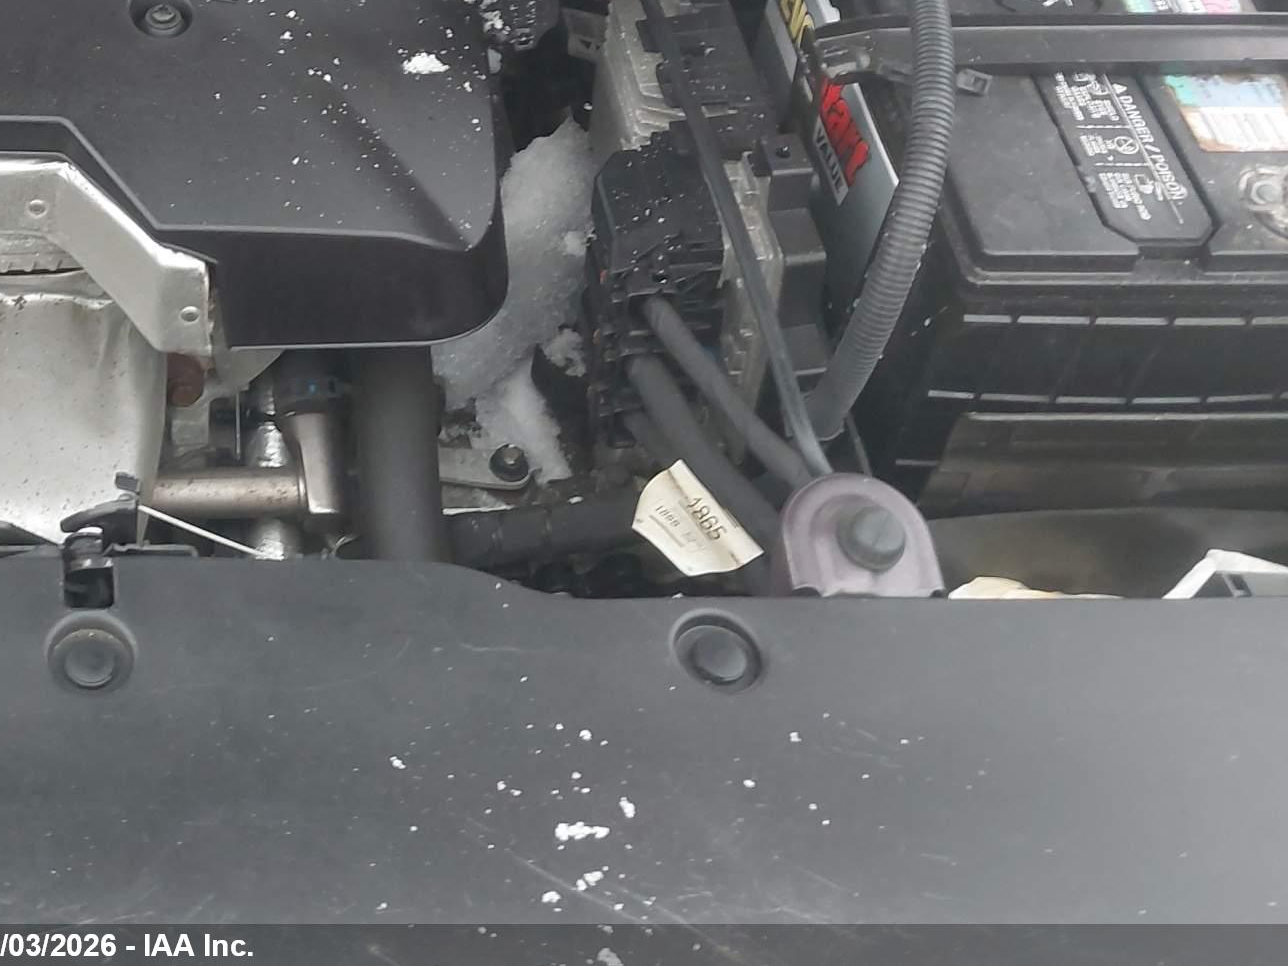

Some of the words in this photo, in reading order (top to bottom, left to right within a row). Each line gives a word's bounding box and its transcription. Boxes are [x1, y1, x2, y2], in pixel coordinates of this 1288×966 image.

[816, 125, 844, 195] VALUE
[1118, 95, 1155, 144] DANGER
[1150, 153, 1184, 202] POISON
[686, 496, 728, 541] 1865
